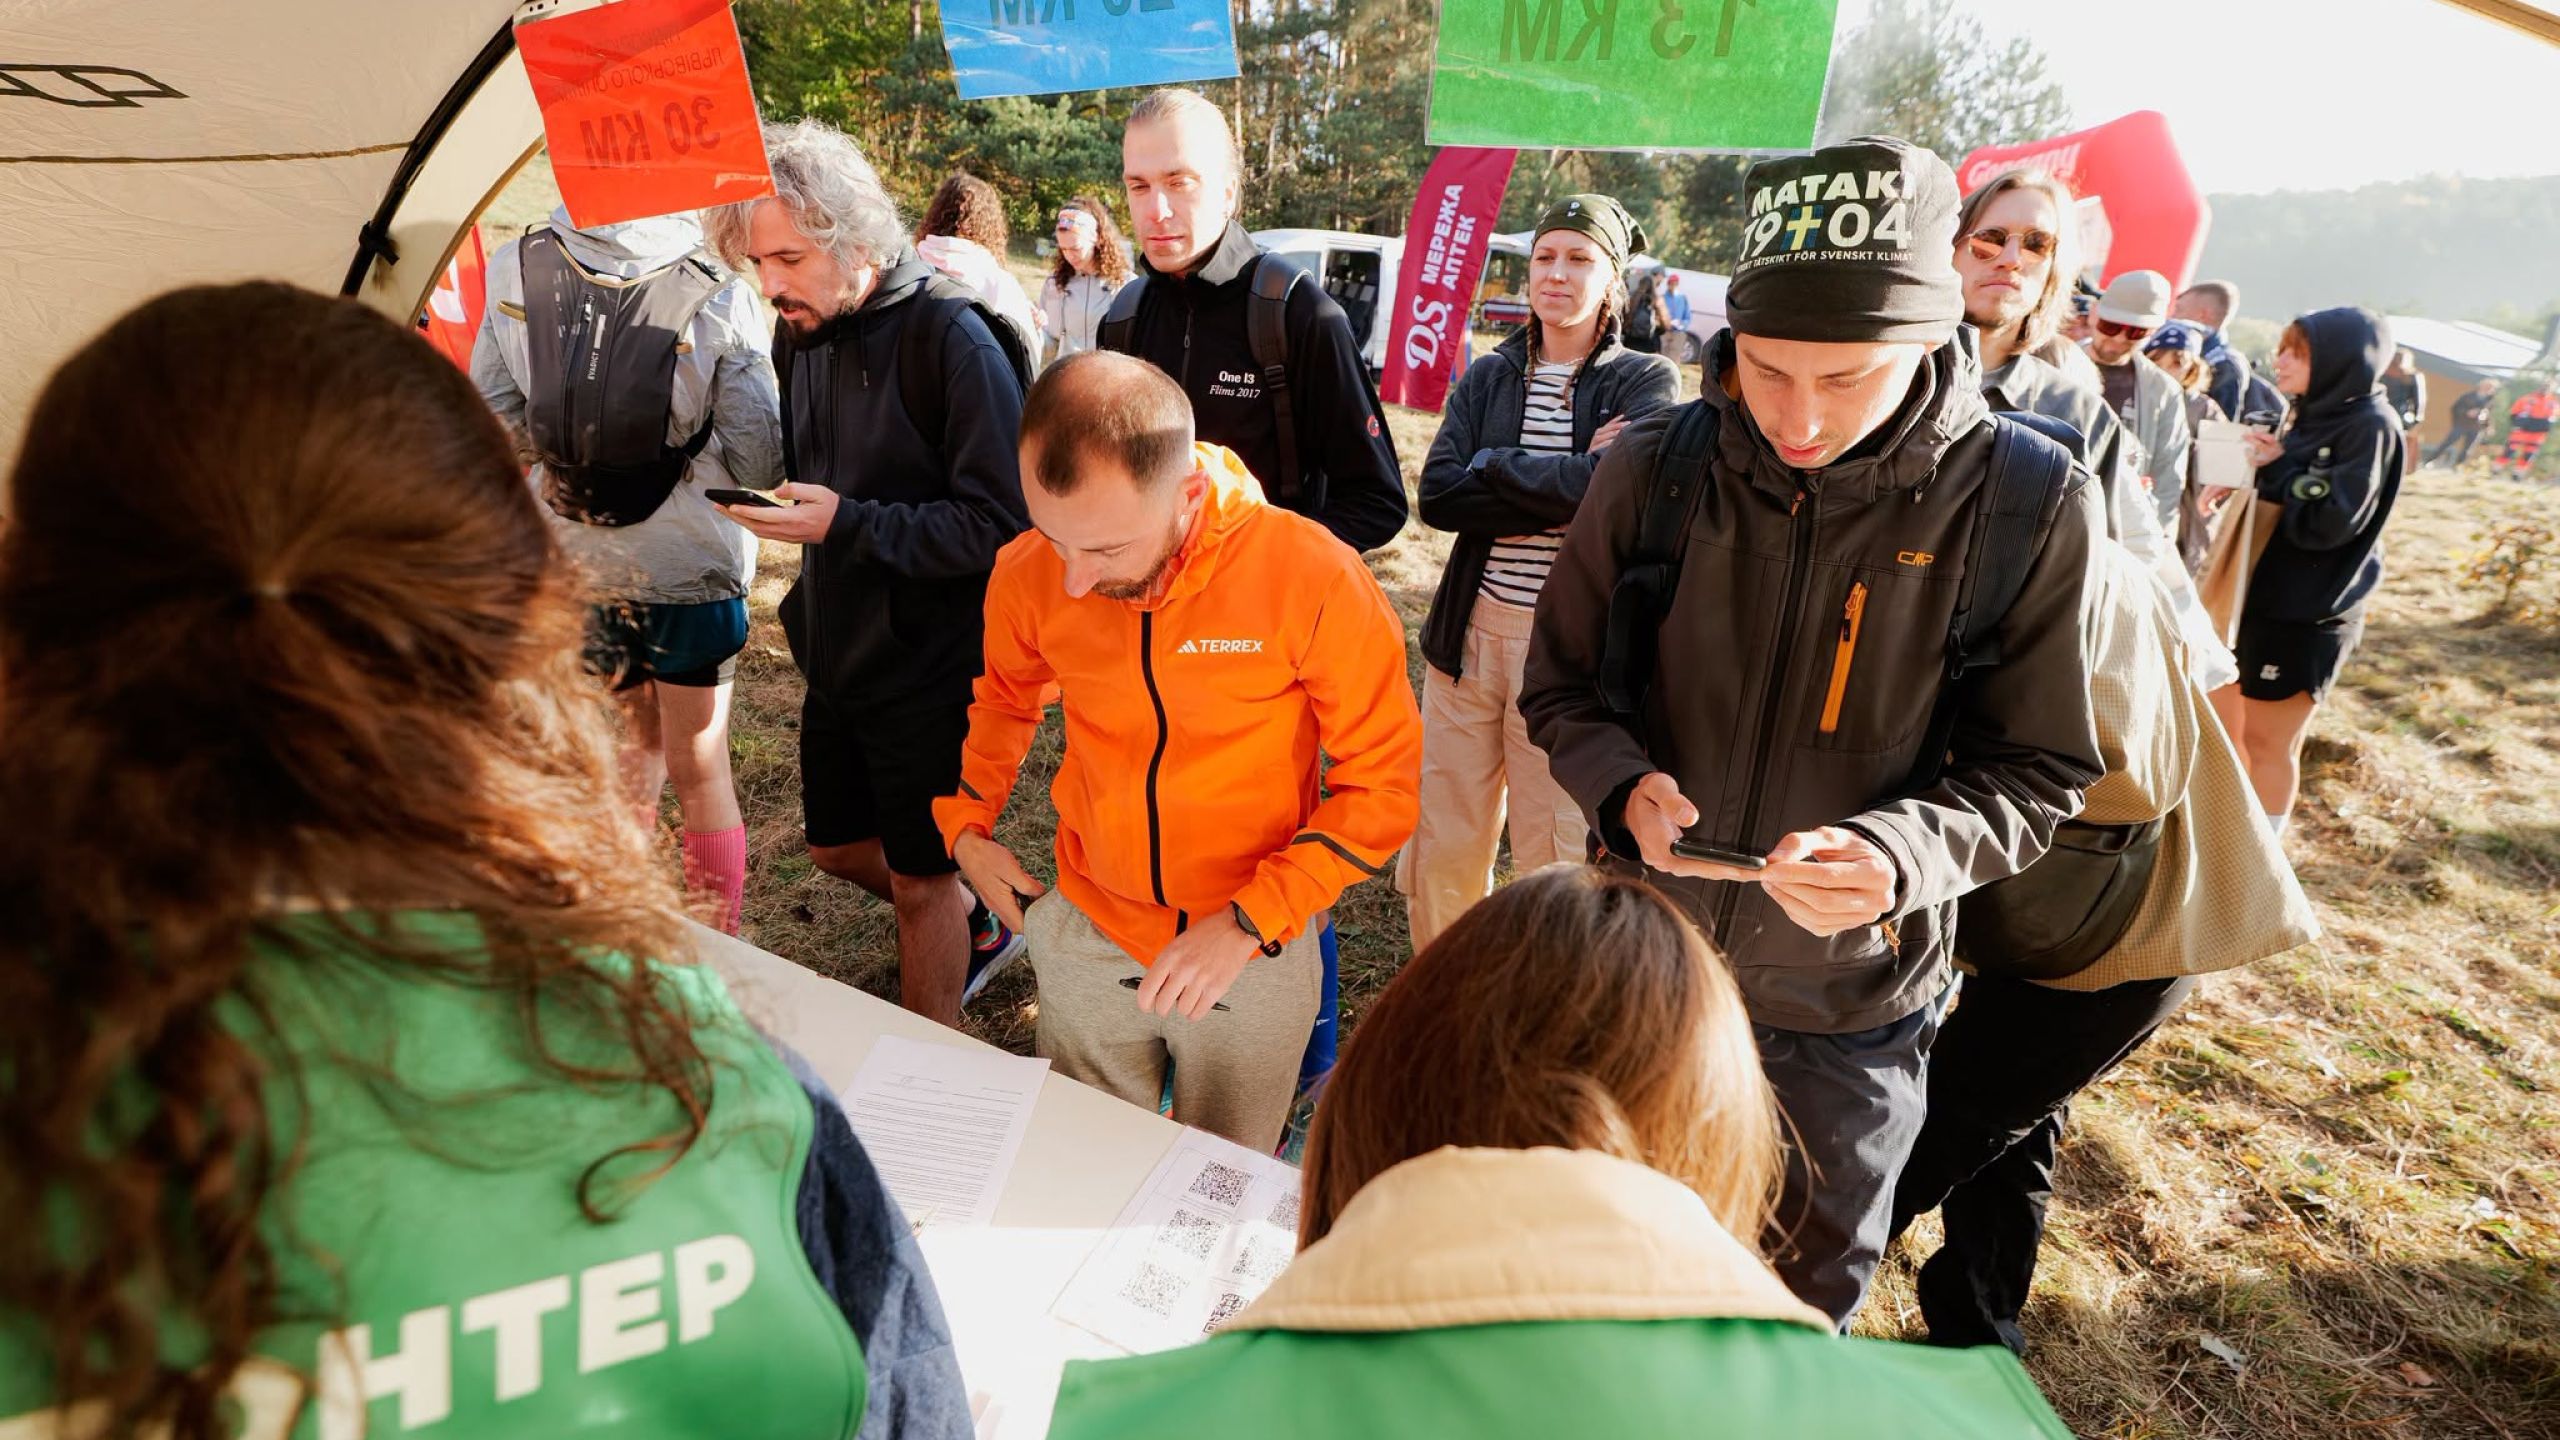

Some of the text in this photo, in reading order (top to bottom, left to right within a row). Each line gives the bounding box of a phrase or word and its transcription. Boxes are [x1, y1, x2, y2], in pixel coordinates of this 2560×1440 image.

[1752, 170, 1916, 218] MATAKI
[1420, 184, 1465, 286] МЕРЕЖА
[1739, 201, 1914, 262] 19 04
[1441, 214, 1477, 292] АПТЕК
[1794, 249, 1817, 262] FÖR
[1820, 250, 1874, 261] SVENSKT
[1876, 251, 1914, 262] KLIMAT
[587, 351, 600, 380] EVADICT
[1218, 370, 1241, 383] One
[1236, 387, 1260, 398] 2017
[1199, 639, 1264, 654] TERREX
